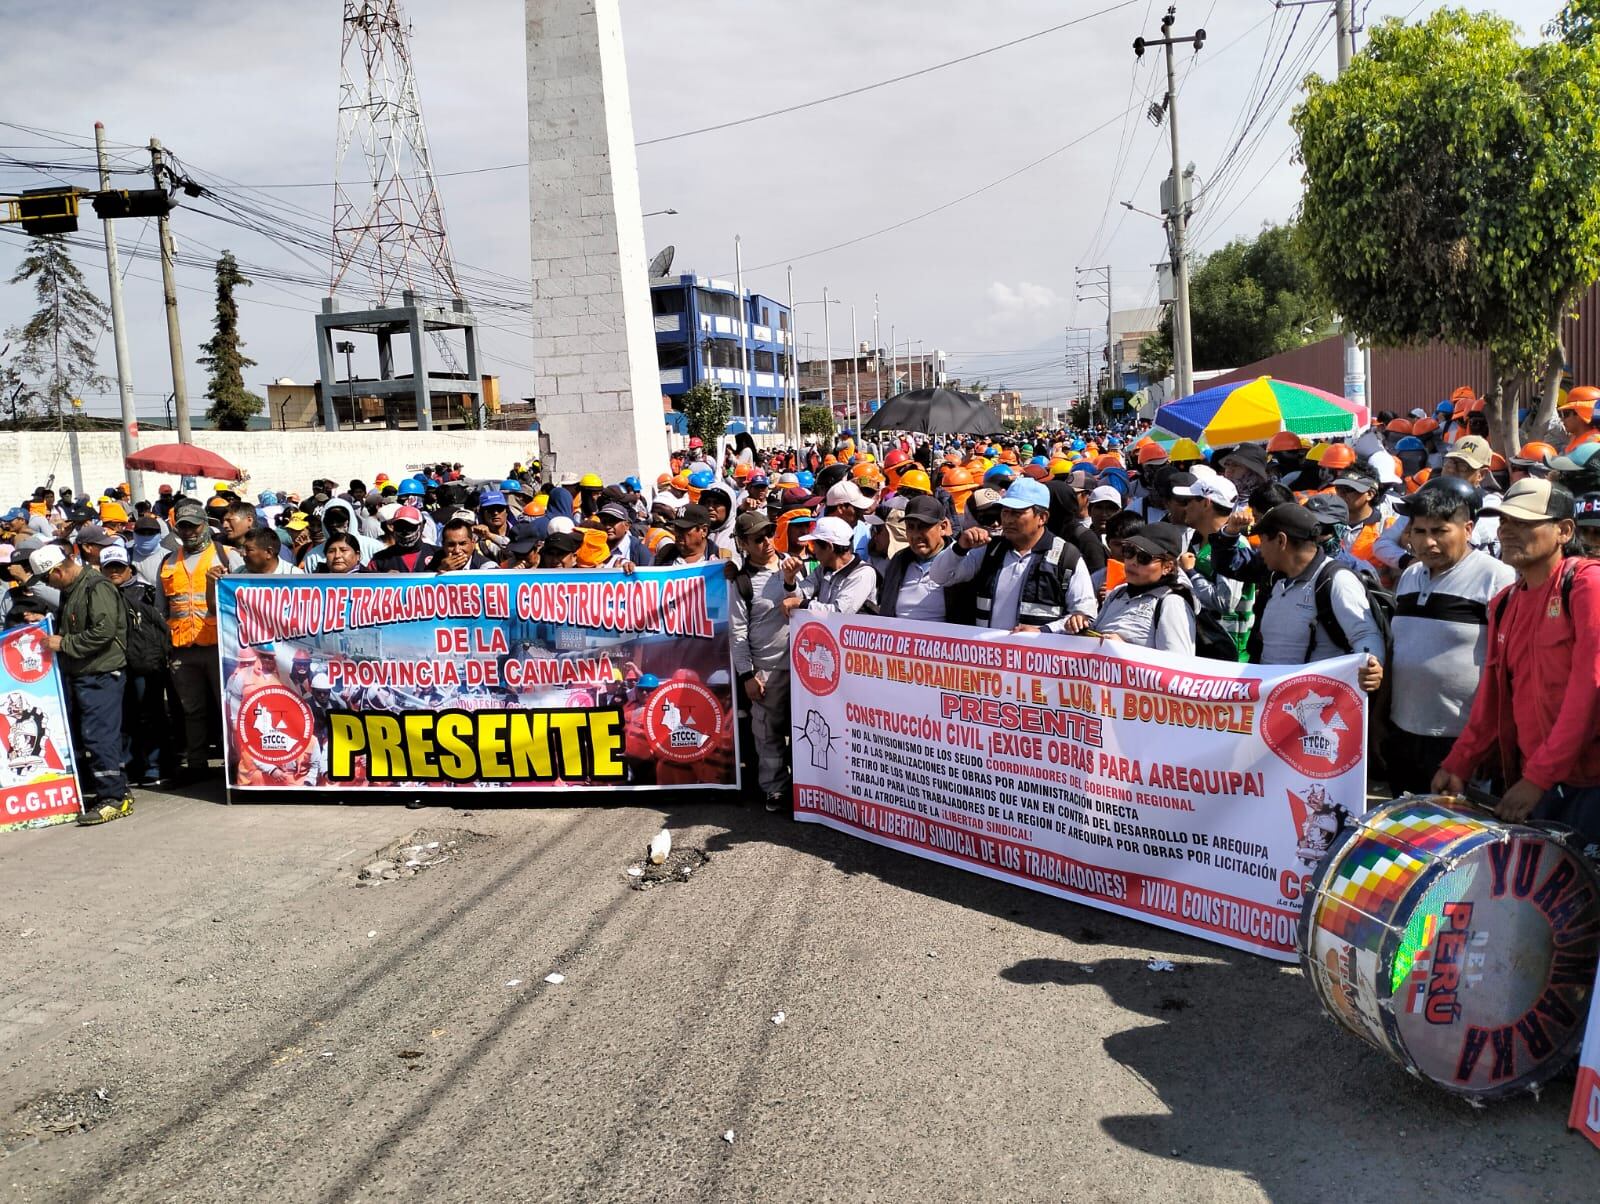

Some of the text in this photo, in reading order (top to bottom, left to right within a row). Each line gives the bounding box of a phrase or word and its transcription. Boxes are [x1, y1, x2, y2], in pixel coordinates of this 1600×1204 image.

[235, 575, 714, 647] SINDICATO DE TRABAJADORES EN CONSTRUCCION CIVIL
[435, 627, 510, 655] DE LA
[327, 652, 616, 688] PROVINCIA DE CAMANÁ
[843, 628, 893, 652] SINDICATO
[896, 636, 911, 655] DE
[914, 638, 1001, 667] TRABAJADORES
[1006, 648, 1021, 670] EN
[1126, 665, 1163, 691] CIVIL
[1168, 675, 1251, 701] AREQUIPA
[845, 651, 883, 679] OBRA:
[886, 657, 1002, 698] MEJORAMIENTO
[1122, 692, 1254, 735] BOURONCLE
[262, 734, 286, 744] STCCC
[328, 708, 625, 781] PRESENTE
[671, 731, 696, 741] STCCC
[846, 702, 942, 742] CONSTRUCCIÓN
[946, 723, 984, 750] CIVIL
[988, 731, 1042, 760] ¡EXIGE
[1048, 740, 1095, 774] OBRAS
[1099, 753, 1144, 785] PARA
[941, 692, 1103, 748] PRESENTE
[1303, 735, 1330, 750] FTCCP
[851, 728, 1196, 812] NO AL DIVISIONISMO DE LOS SEUDO COORDINADORES DEL GOBIERNO REGIONAL
[851, 742, 1139, 821] NO A LAS PARALIZACIONES DE OBRAS POR ADMINISTRACIÓN DIRECTA
[851, 756, 1269, 860] RETIRO DE LOS MALOS FUNCIONARIOS QUE VAN EN CONTRA DEL DESARROLLO DE AREQUIPA
[851, 785, 1033, 841] NO AL ATROPELLO DE LA ¡LIBERTAD SINDICAL!
[851, 770, 1277, 882] TRABAJO PARA LOS TRABAJADORES DE LA REGION DE AREQUIPA POR OBRAS POR LICITACIÓN
[799, 788, 859, 822] DEFENDIENDO
[879, 809, 927, 843] LIBERTAD
[929, 823, 979, 858] SINDICAL
[980, 839, 996, 864] DE
[999, 844, 1021, 871] LOS
[1024, 851, 1127, 900] TRABAJADORES!
[1140, 879, 1177, 914] ¡VIVA
[1181, 889, 1300, 946] CONSTRUCCION
[1425, 901, 1474, 1024] PERÚ
